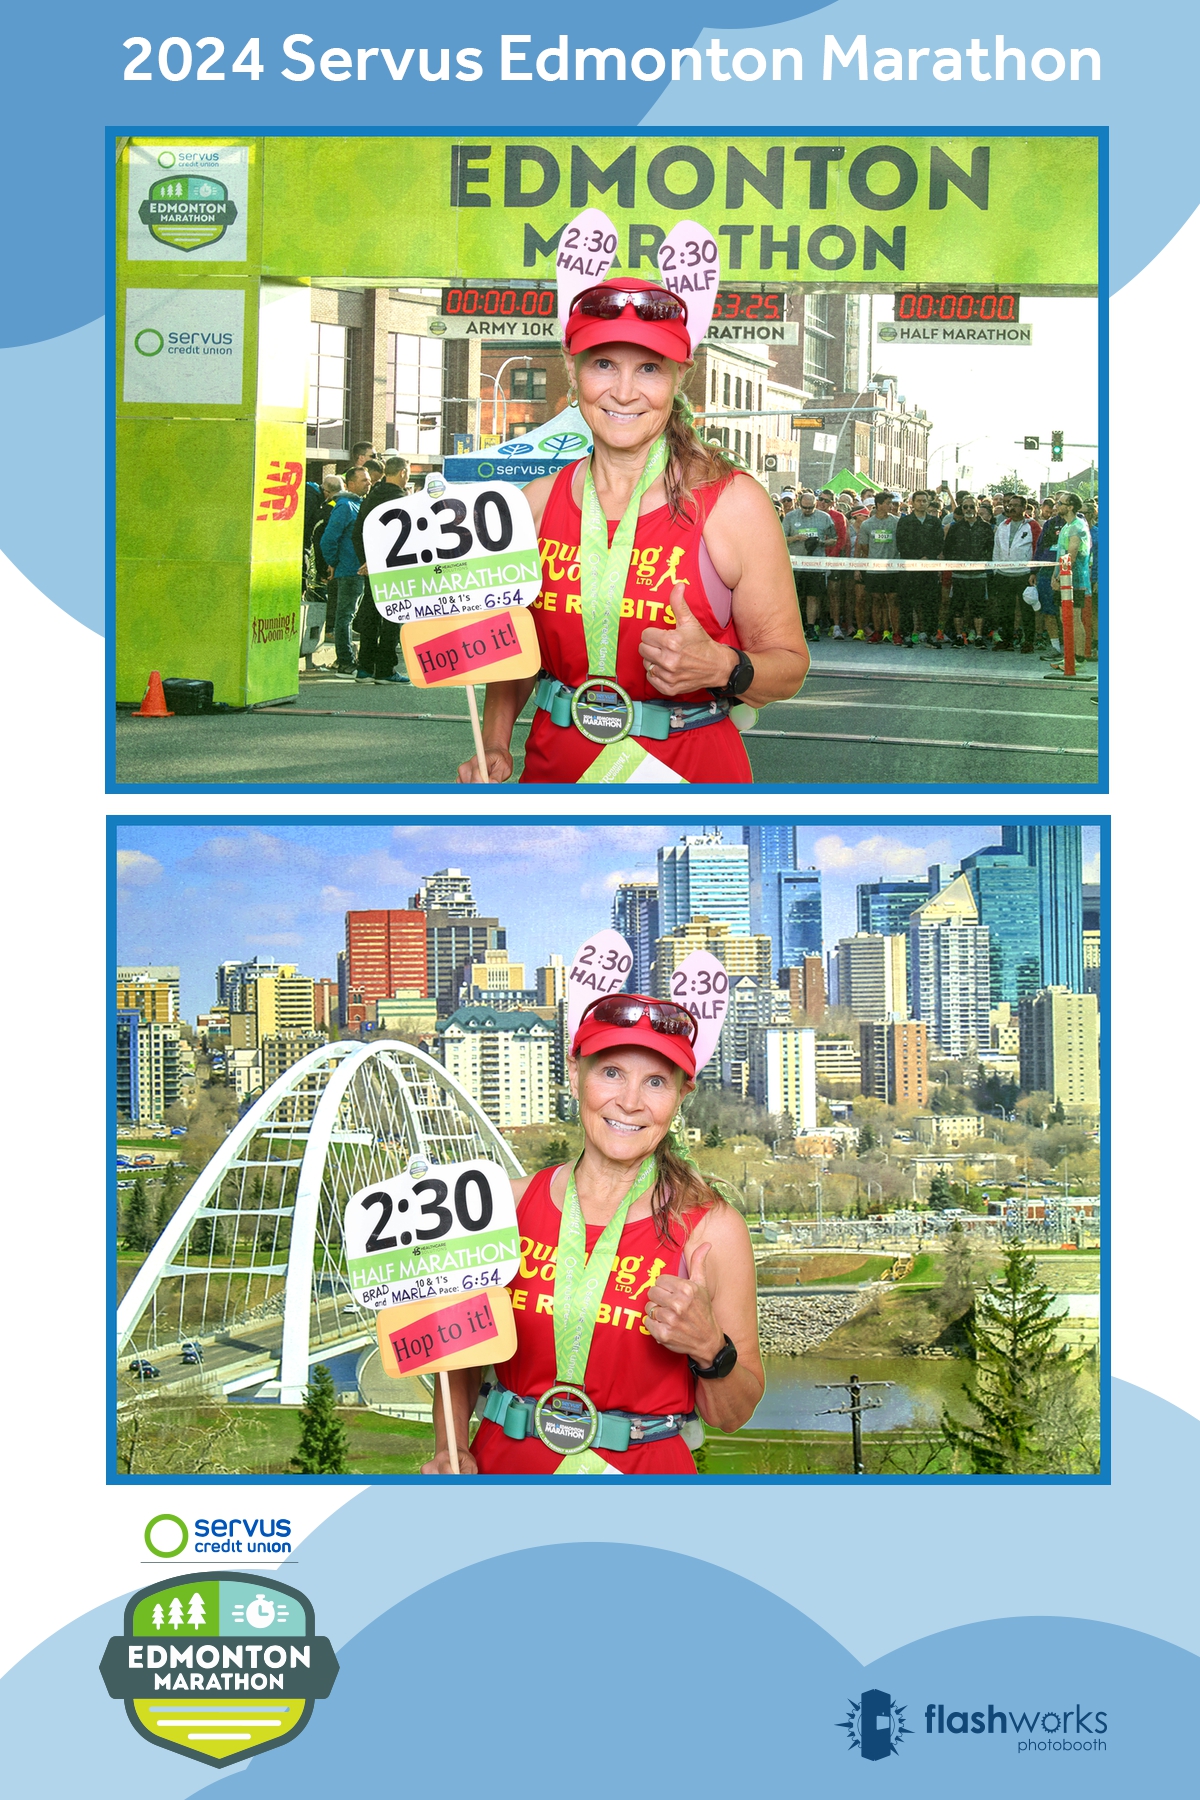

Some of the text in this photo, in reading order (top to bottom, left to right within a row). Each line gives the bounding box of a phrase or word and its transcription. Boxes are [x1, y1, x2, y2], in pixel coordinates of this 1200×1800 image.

[178, 151, 220, 161] servus
[450, 144, 991, 210] EDMONTON
[150, 202, 227, 213] EDMONTON
[160, 214, 216, 222] MARATHON
[522, 221, 907, 271] MRTHON
[564, 227, 618, 254] 2:30
[556, 251, 610, 277] HALF
[658, 239, 718, 271] 2:30
[665, 269, 717, 294] HALF
[465, 320, 554, 336] ARMY 10K
[703, 325, 785, 340] RATHON
[900, 327, 1031, 341] HALF MARATHON
[168, 331, 233, 345] servus
[168, 344, 233, 355] credit union
[496, 465, 545, 475] servus
[378, 490, 513, 568] 2:30
[373, 561, 539, 601] HALF MARATHON
[438, 596, 448, 605] 10
[484, 588, 524, 609] 6:54
[385, 599, 412, 617] BRAD
[397, 612, 411, 621] and
[414, 603, 460, 618] MARLA
[461, 603, 482, 613] Pace:
[257, 613, 290, 643] Running
[418, 623, 517, 674] Hop to it!
[582, 718, 622, 729] MARATHON
[579, 944, 632, 973] 2:30
[569, 966, 623, 993] HALF
[671, 970, 728, 996] 2:30
[360, 1169, 493, 1253] 2:30
[352, 1239, 518, 1288] HALF MARATHON
[415, 1279, 425, 1288] 10
[462, 1268, 502, 1290] 6:54
[362, 1284, 390, 1303] BRAD
[391, 1286, 438, 1304] MARLA
[438, 1285, 460, 1295] Pace:
[374, 1299, 387, 1308] and
[392, 1304, 493, 1363] Hop to it!
[566, 1291, 593, 1381] servus credit union
[545, 1426, 585, 1440] MARATHON
